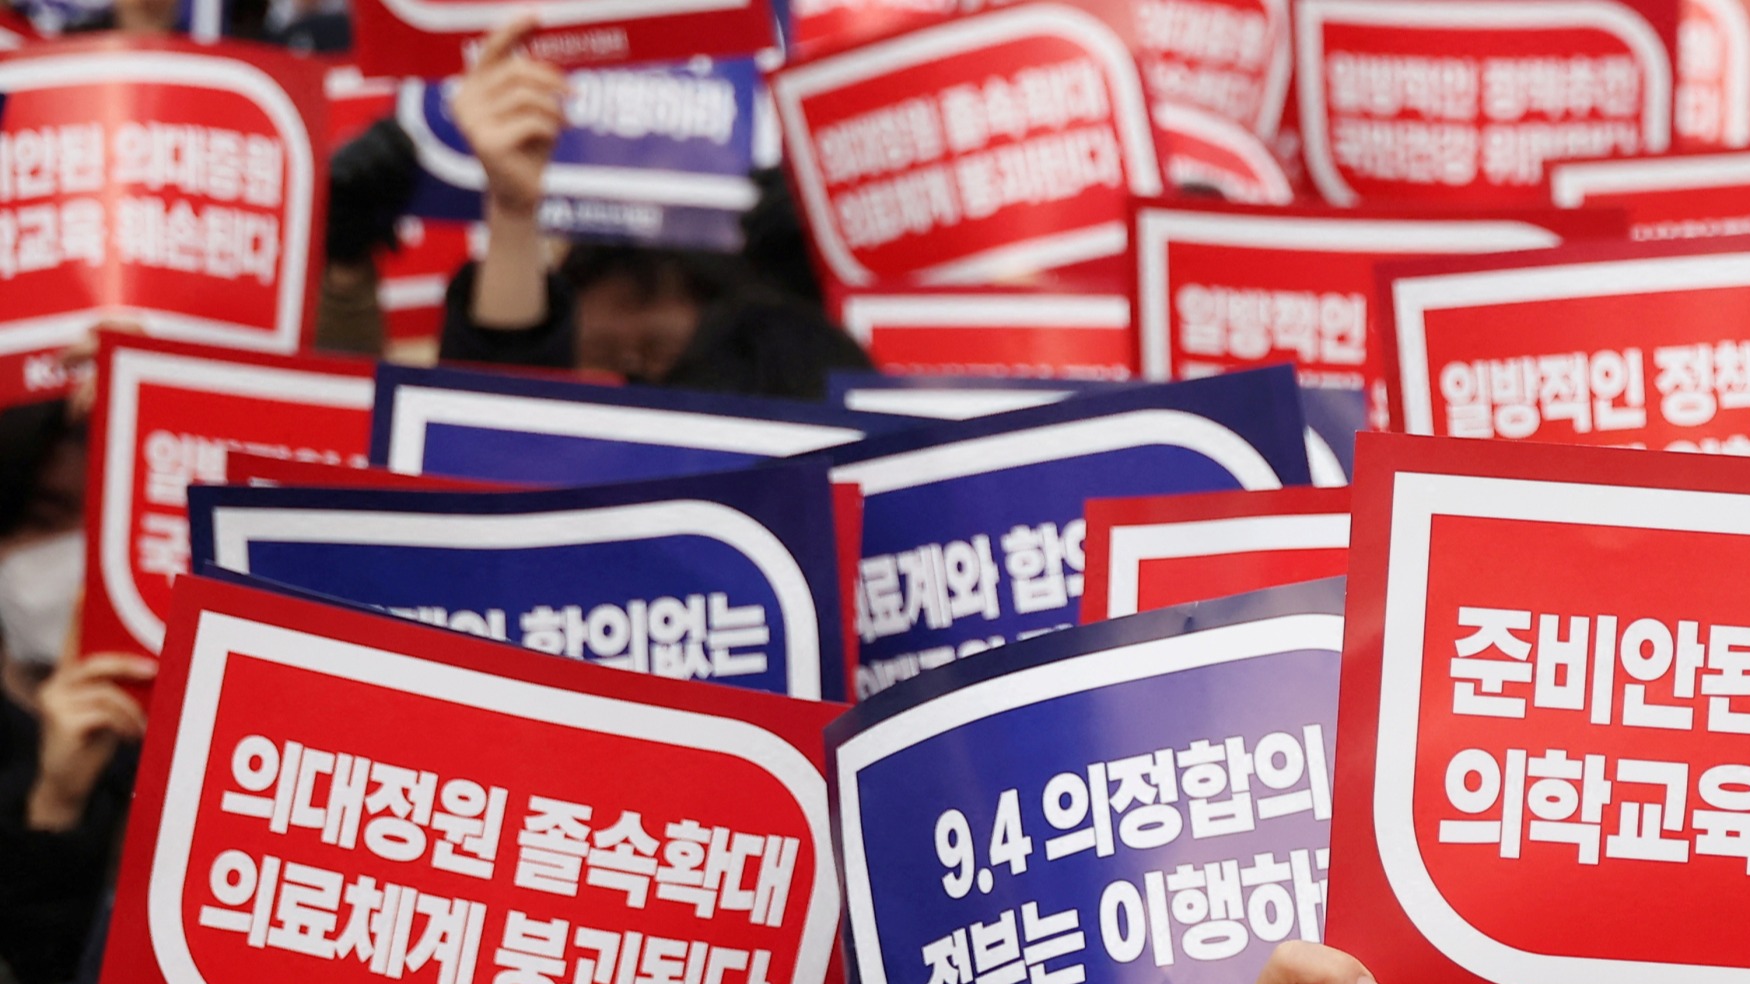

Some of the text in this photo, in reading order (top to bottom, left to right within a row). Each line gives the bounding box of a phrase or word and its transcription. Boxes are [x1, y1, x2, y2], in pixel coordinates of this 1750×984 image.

[0, 120, 286, 209] 안된 의대증원
[115, 196, 281, 286] 훼손된다
[1176, 284, 1367, 366] 일방적인
[1440, 348, 1647, 440] 일방적인
[856, 533, 999, 644] 료계와
[220, 734, 800, 929] 의대정원 졸속확대
[933, 723, 1333, 900] 9.4 의정합의
